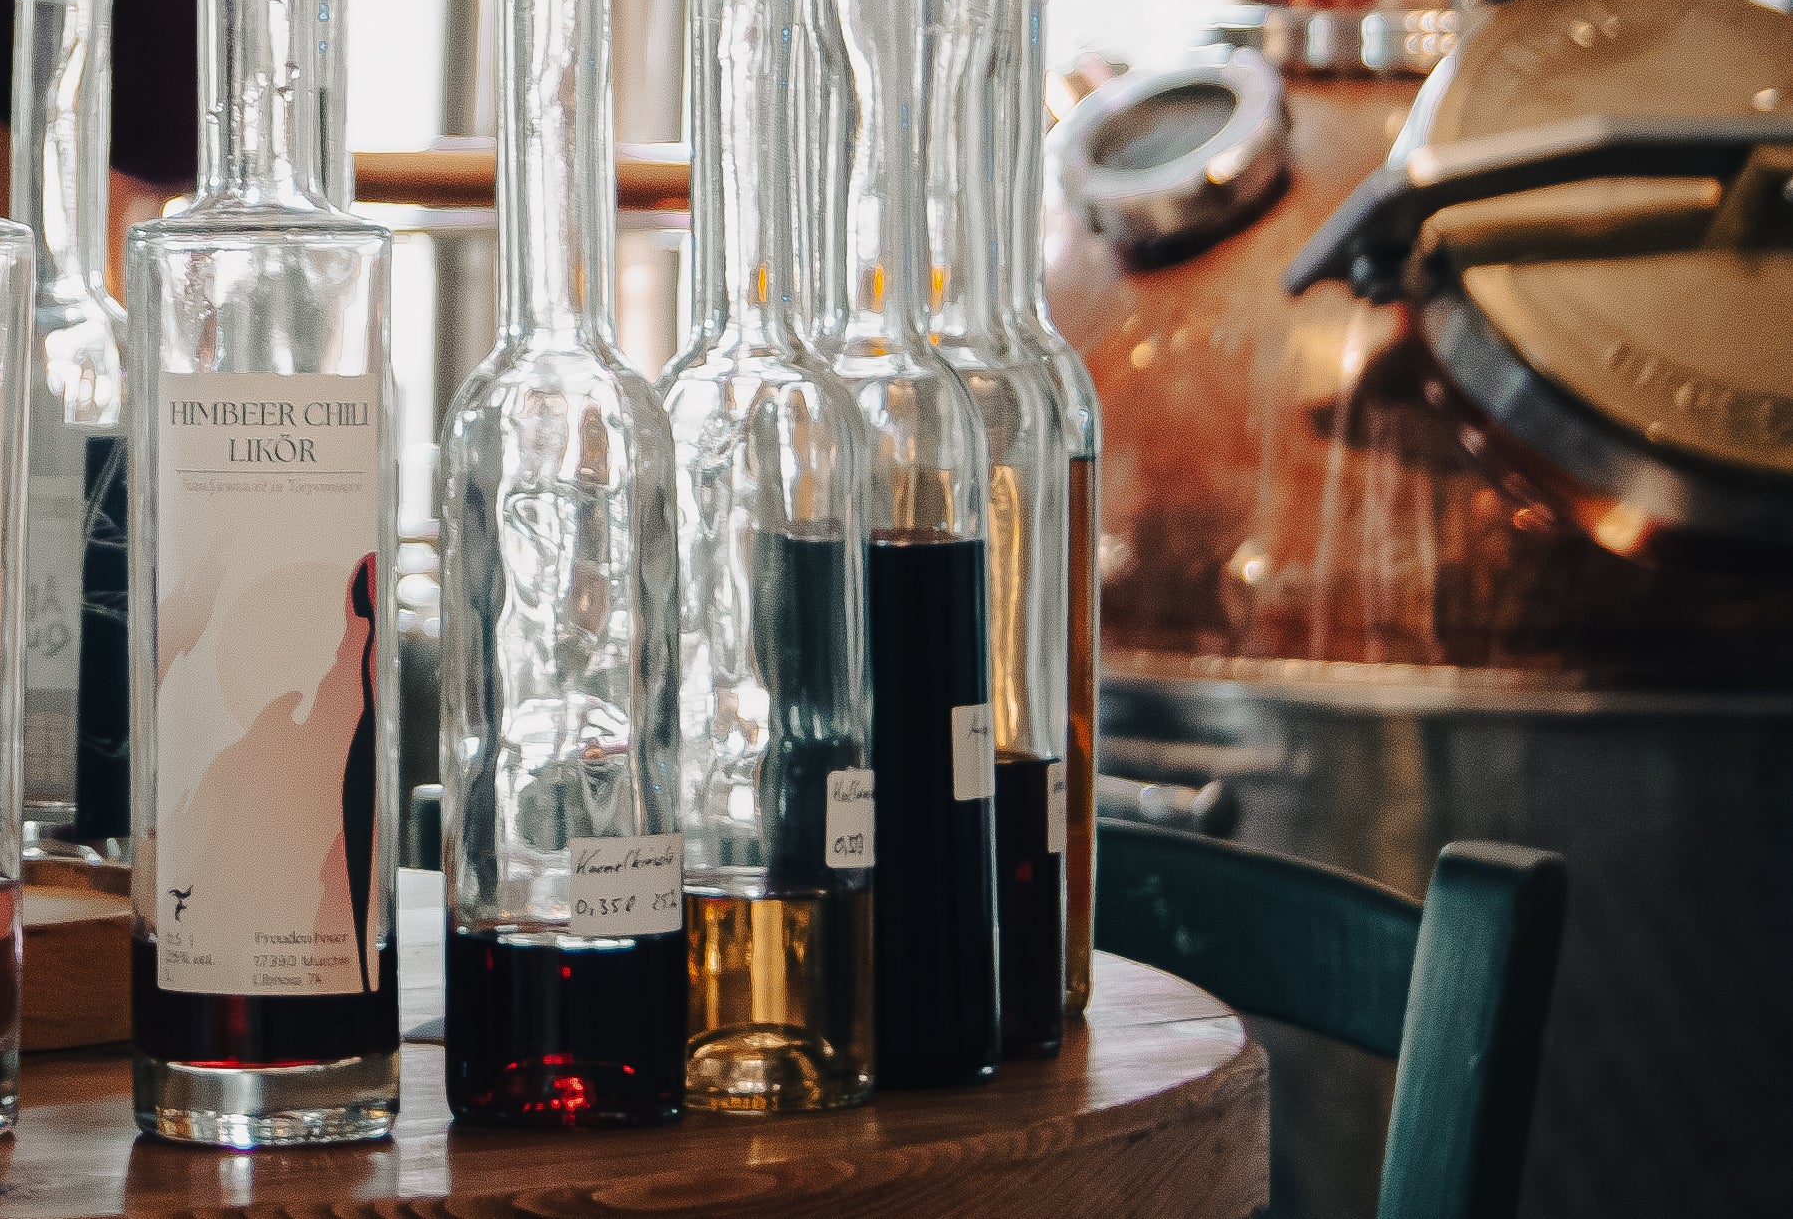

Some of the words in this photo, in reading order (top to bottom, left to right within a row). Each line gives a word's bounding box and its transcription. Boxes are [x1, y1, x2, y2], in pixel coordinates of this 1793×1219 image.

[170, 401, 296, 427] HIMBEER
[303, 402, 369, 426] CHILI
[229, 434, 316, 462] LIKÖR
